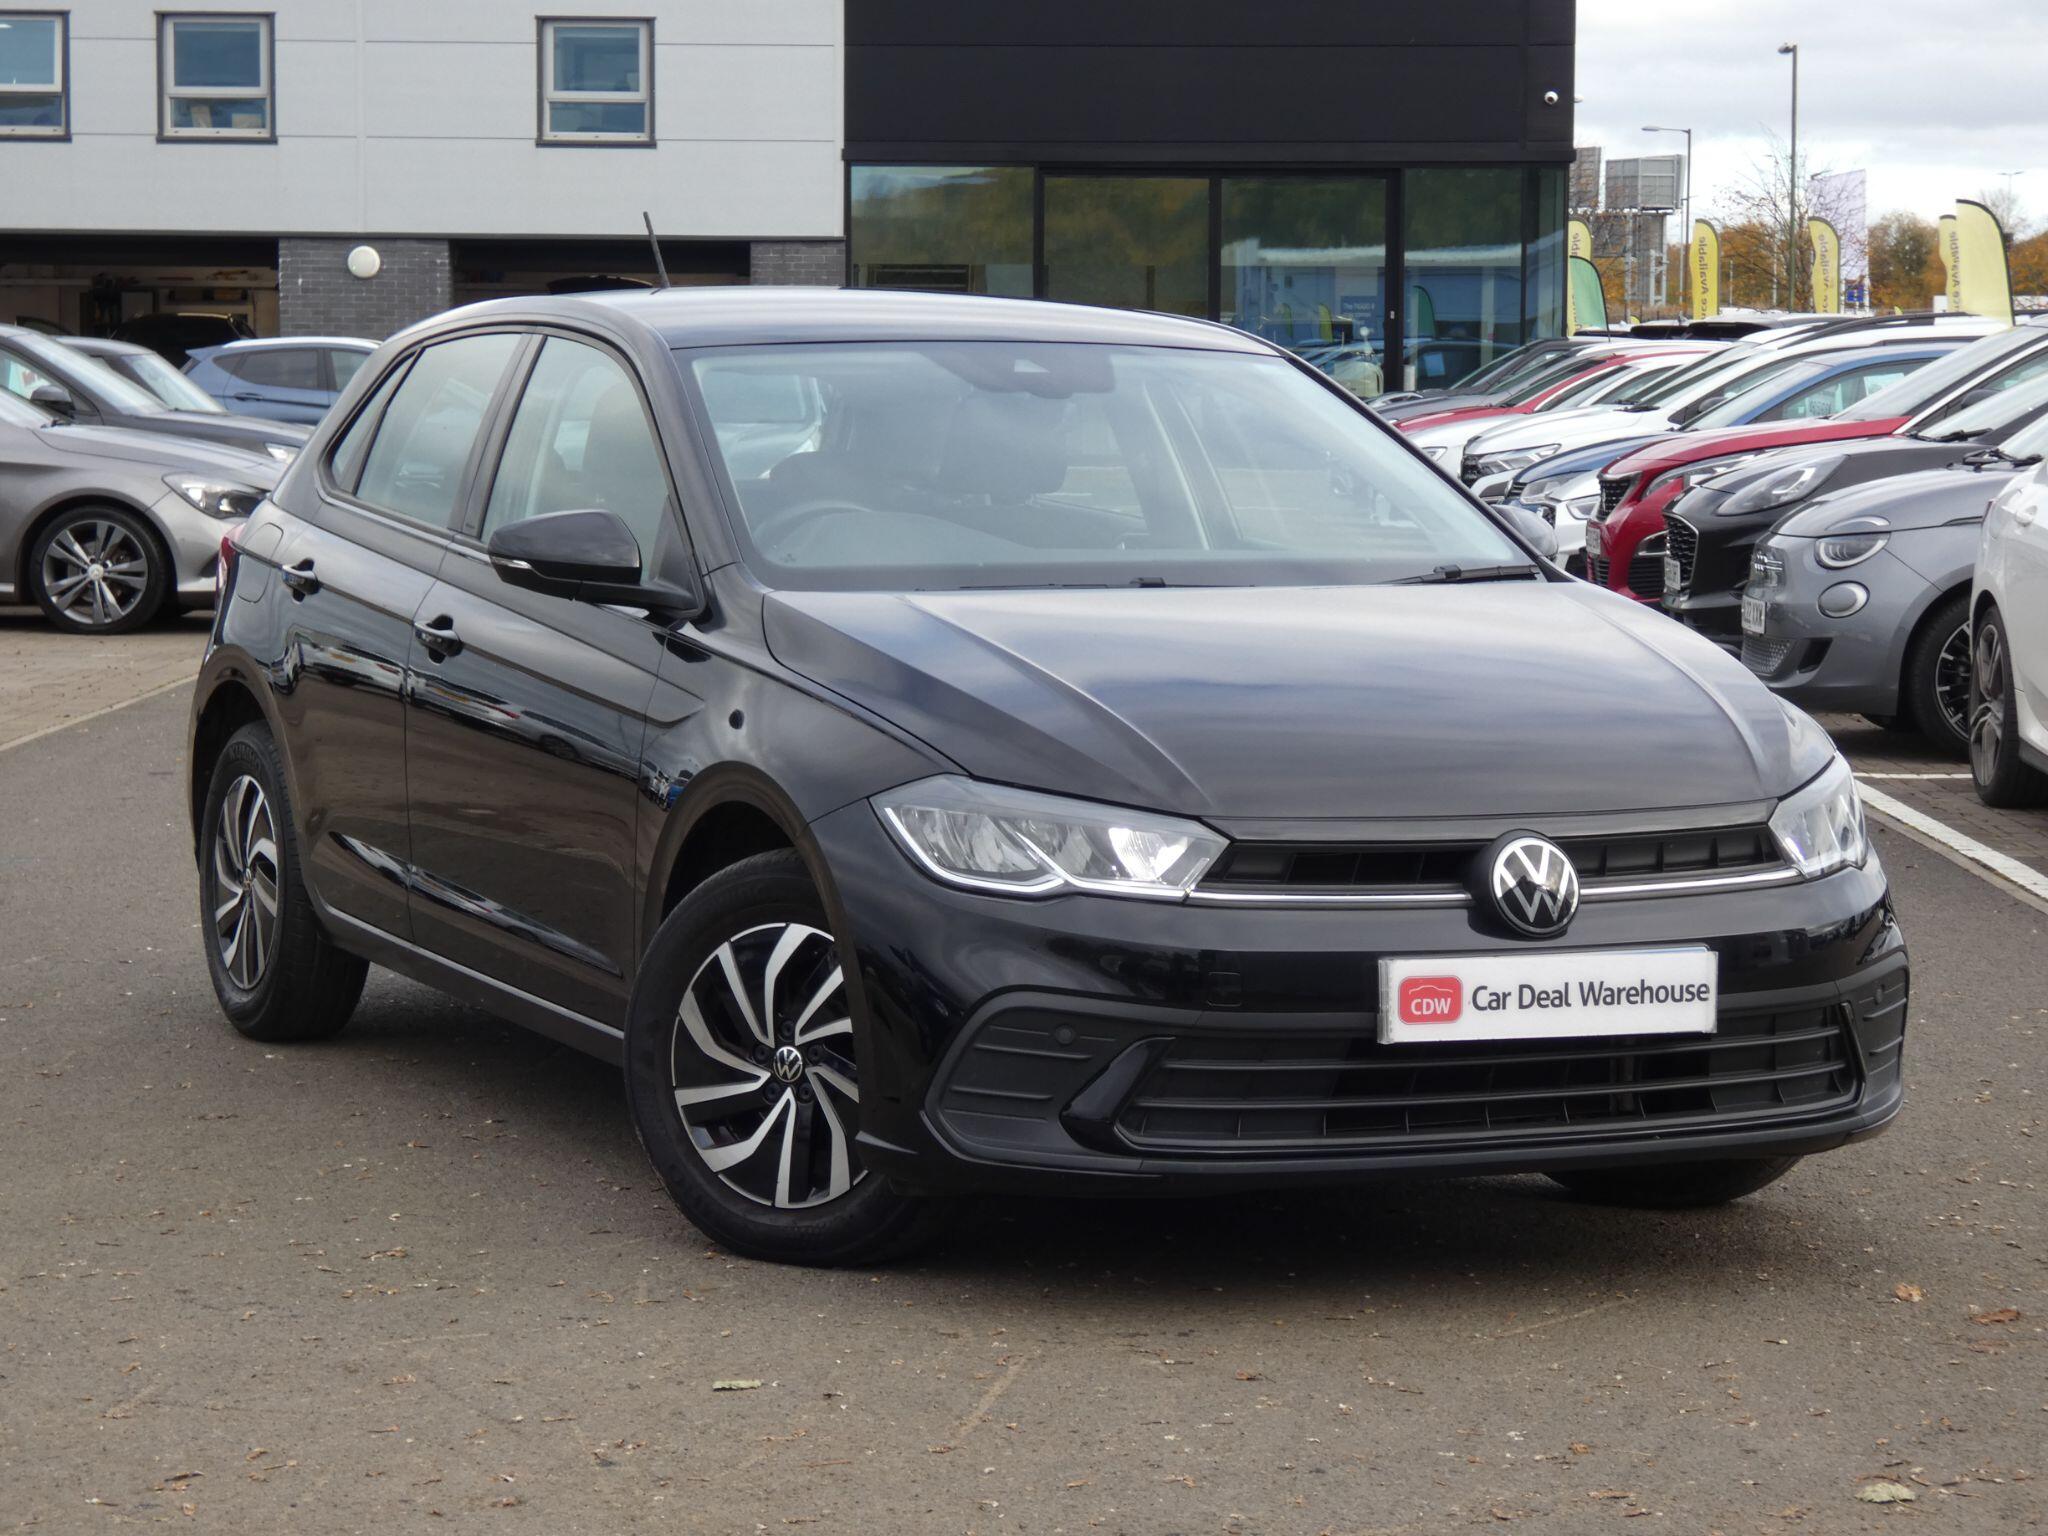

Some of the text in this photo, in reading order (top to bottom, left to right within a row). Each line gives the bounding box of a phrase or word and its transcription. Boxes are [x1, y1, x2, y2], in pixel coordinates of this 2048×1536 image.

[1410, 998, 1452, 1016] CDW
[1472, 979, 1711, 1011] Car Deal Warehouse
